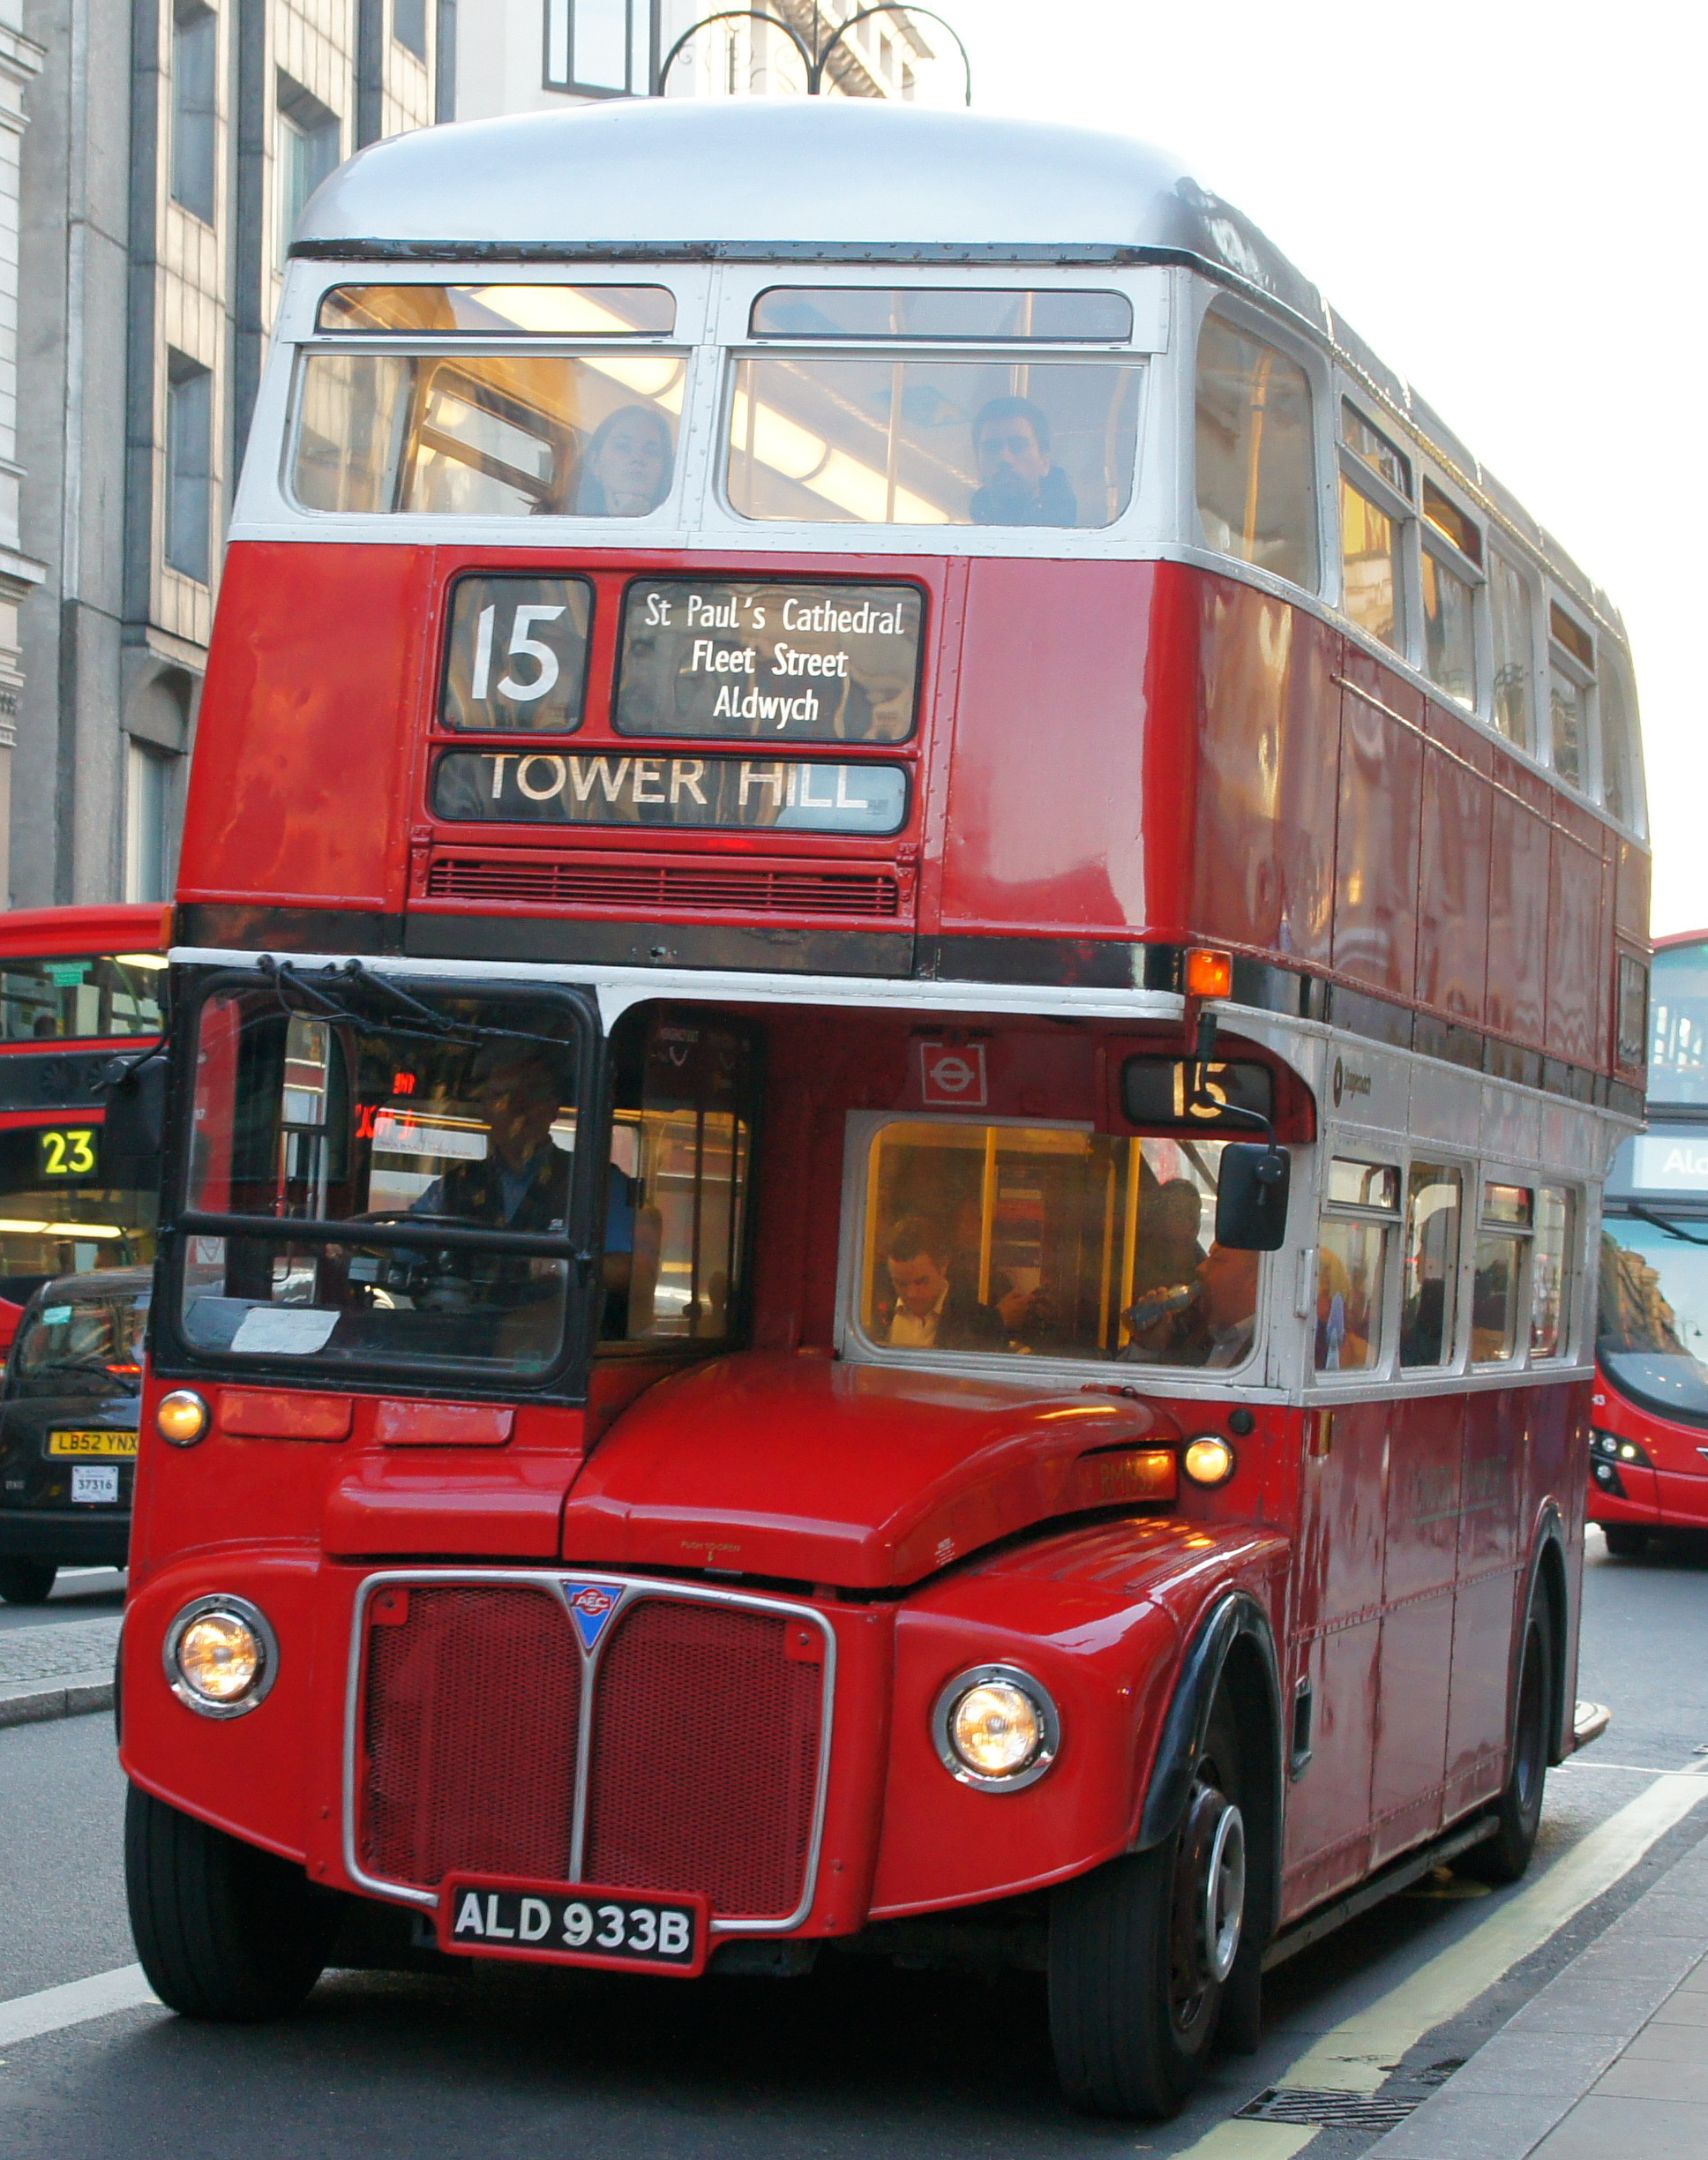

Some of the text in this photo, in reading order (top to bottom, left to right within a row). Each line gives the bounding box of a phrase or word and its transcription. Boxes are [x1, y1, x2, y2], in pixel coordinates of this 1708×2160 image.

[645, 593, 906, 635] St Paul's Cathedral
[470, 604, 567, 701] 15
[691, 640, 849, 678] Fleet Street
[713, 684, 820, 730] Aldwych
[481, 753, 870, 809] TOWER HILL
[1172, 1061, 1228, 1119] 15
[41, 1130, 94, 1174] 23
[58, 1434, 139, 1450] LB52 YNX
[78, 1479, 113, 1490] 37316
[575, 1594, 610, 1609] AEC
[453, 1892, 690, 1955] ALD 933B
